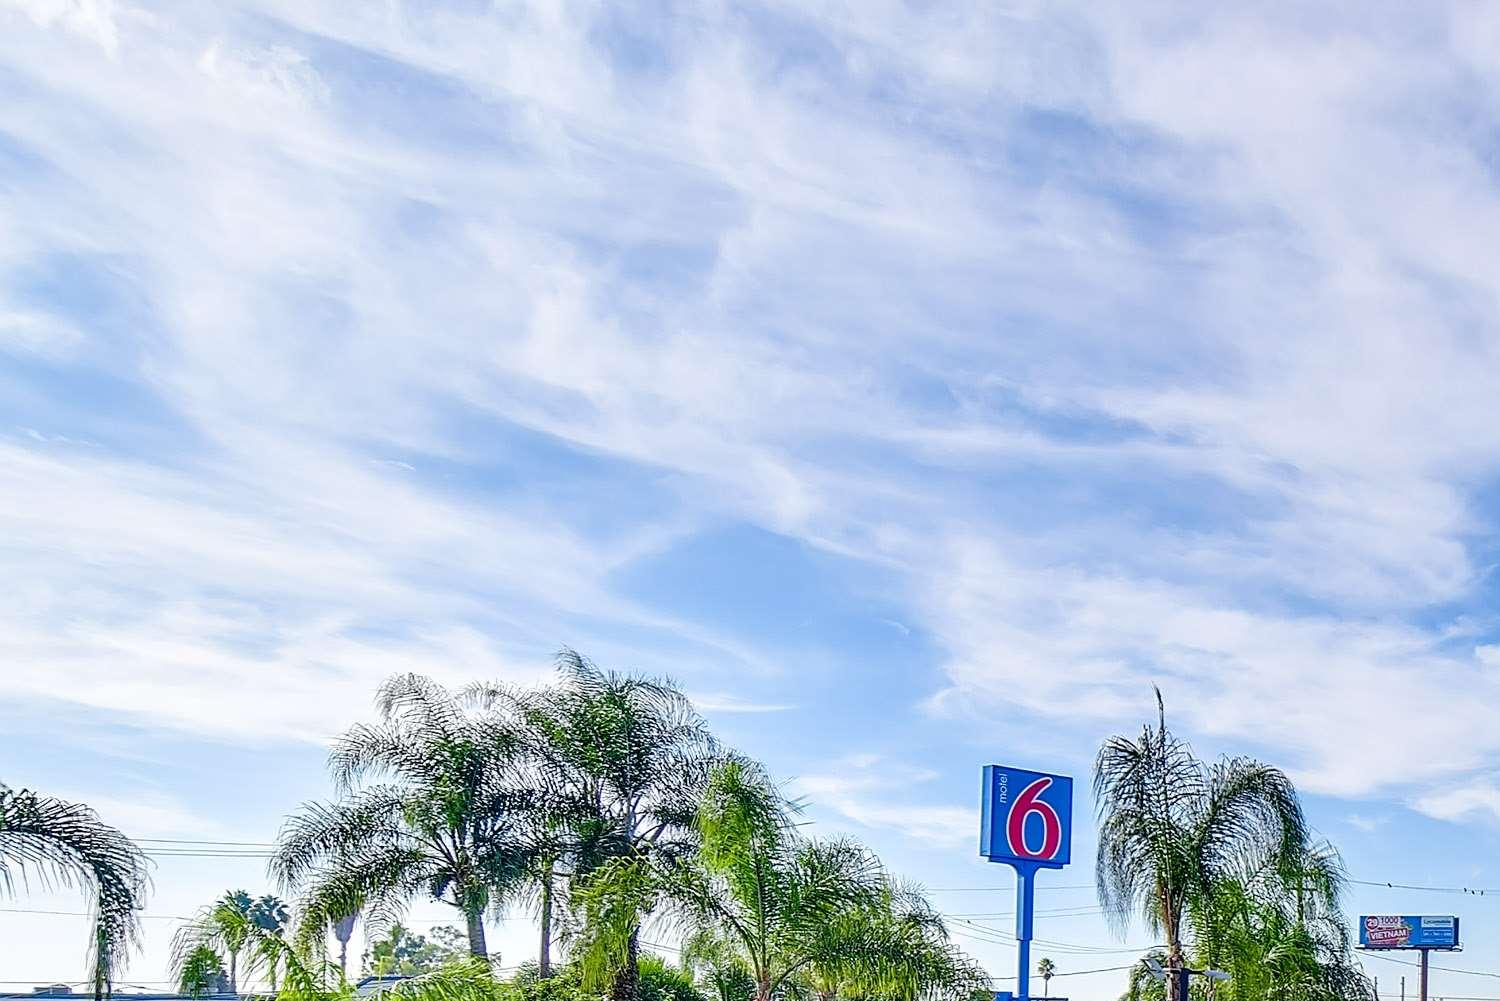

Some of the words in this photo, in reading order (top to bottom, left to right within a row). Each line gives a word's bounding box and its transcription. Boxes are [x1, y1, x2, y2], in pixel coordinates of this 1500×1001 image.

[999, 773, 1008, 804] motel
[1006, 777, 1062, 860] 6
[1369, 929, 1407, 940] VIETNAM
